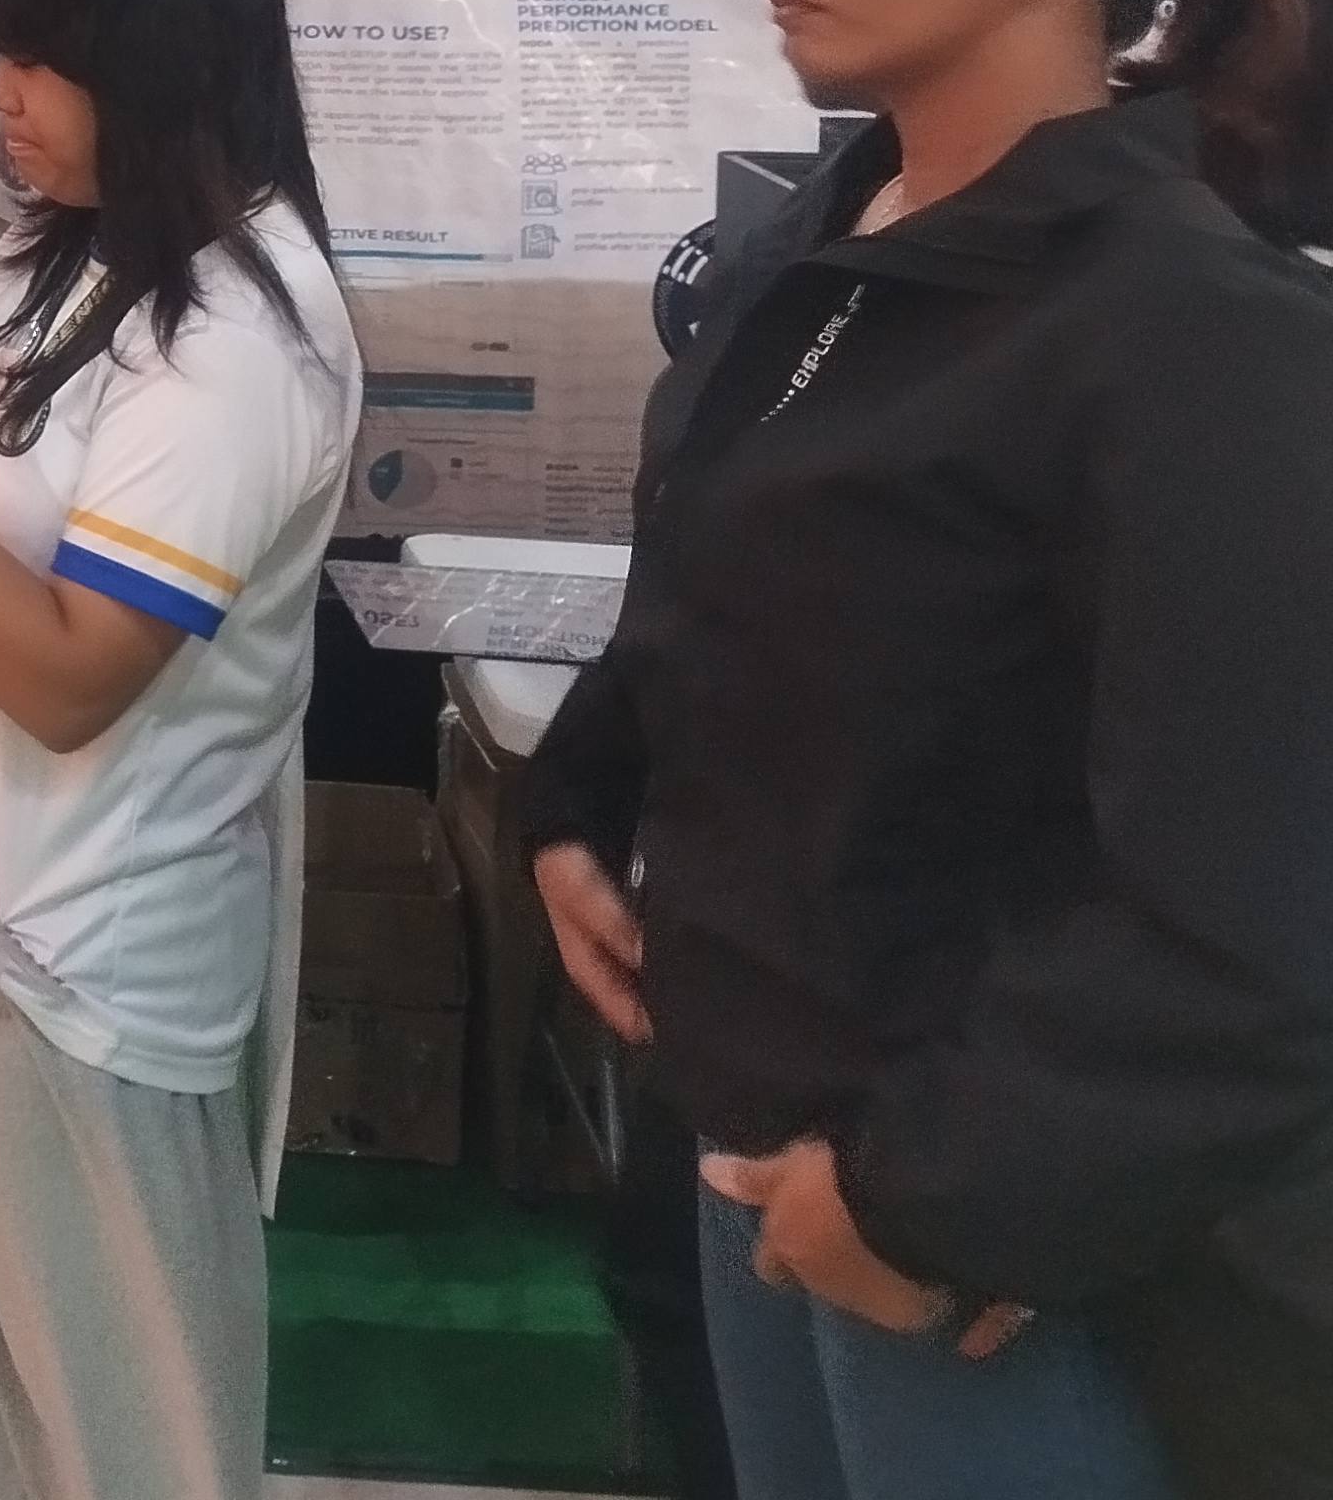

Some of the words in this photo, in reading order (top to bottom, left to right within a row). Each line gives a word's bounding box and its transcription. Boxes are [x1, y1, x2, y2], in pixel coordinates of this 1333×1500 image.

[517, 4, 670, 17] PERFORMANCE
[519, 20, 638, 32] PREDICTION
[645, 19, 719, 32] MODEL
[288, 25, 346, 39] HOW
[353, 25, 385, 40] TO
[392, 26, 449, 41] USE?
[329, 228, 378, 240] CTIVE
[383, 230, 449, 243] RESULT
